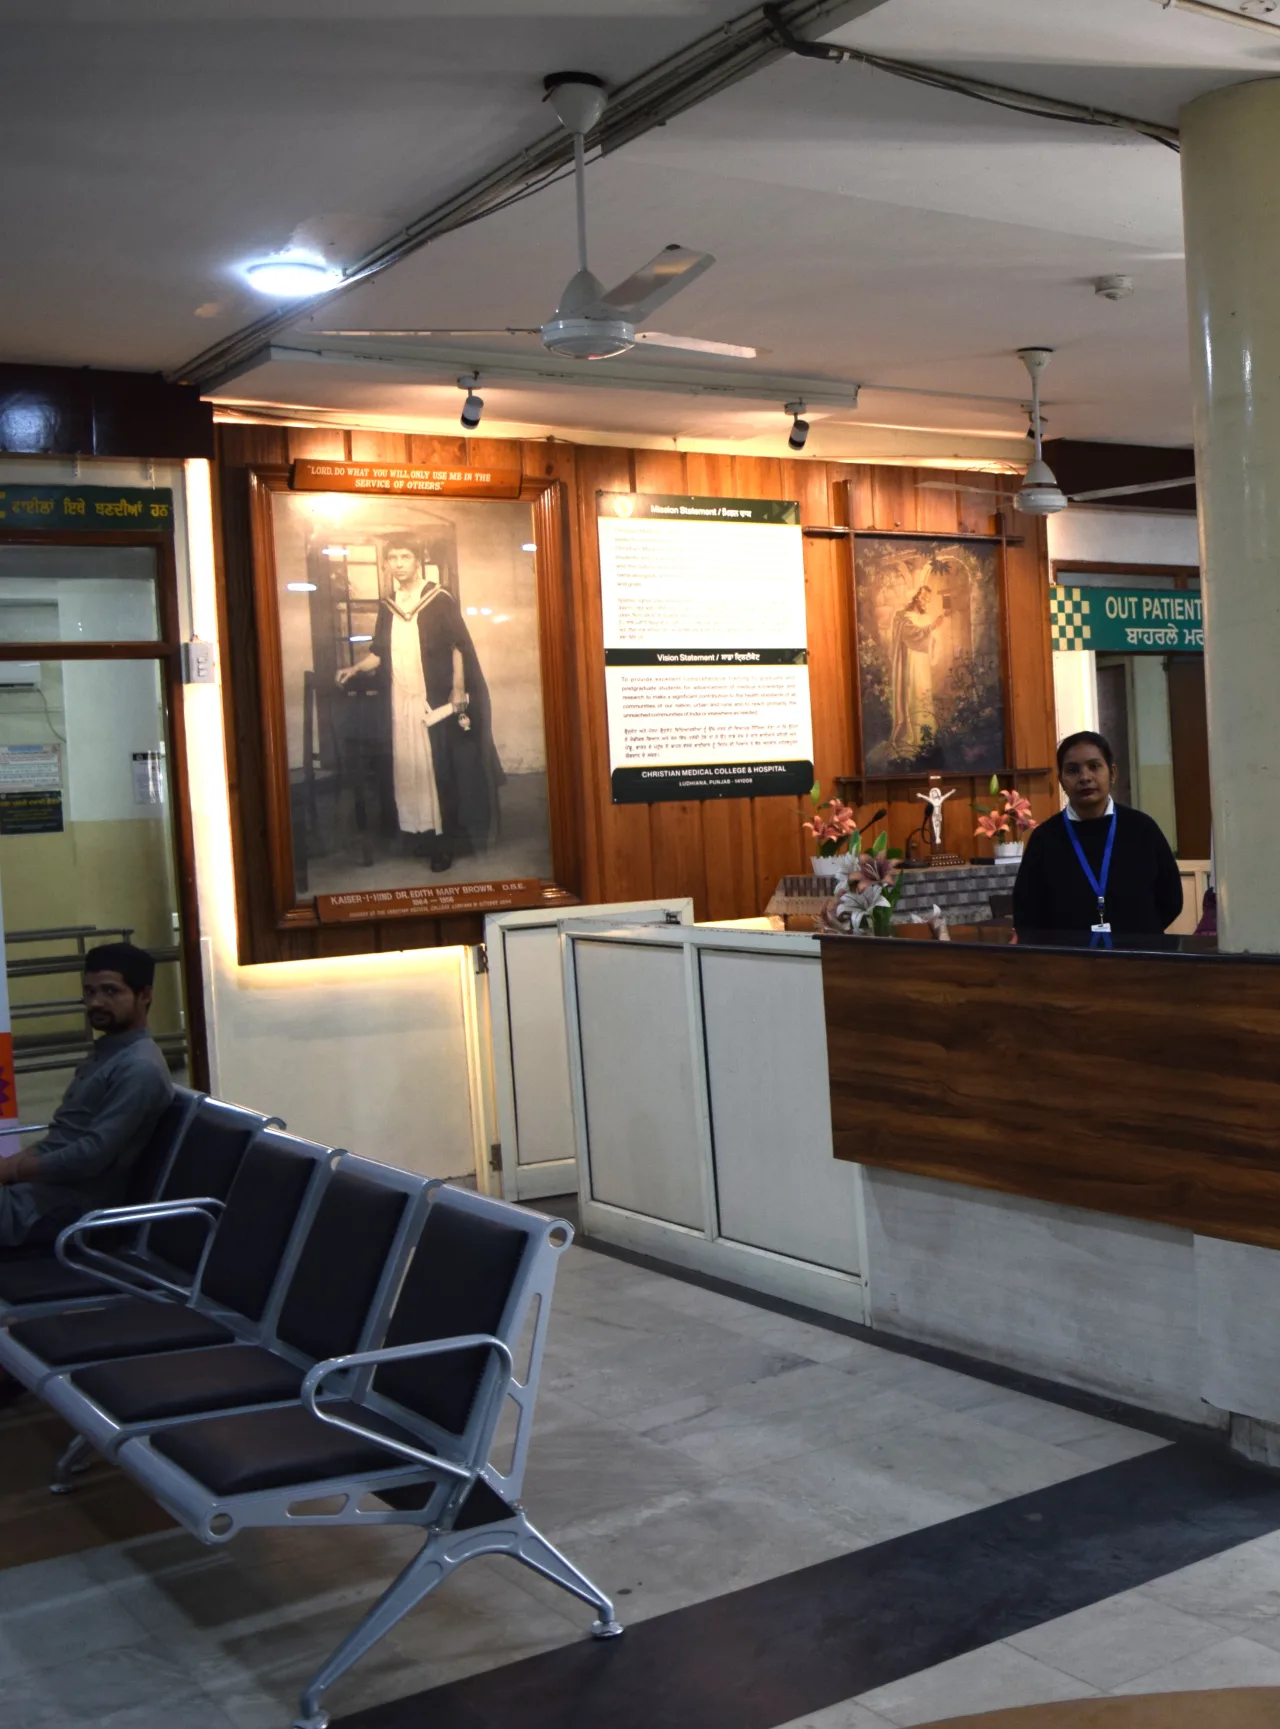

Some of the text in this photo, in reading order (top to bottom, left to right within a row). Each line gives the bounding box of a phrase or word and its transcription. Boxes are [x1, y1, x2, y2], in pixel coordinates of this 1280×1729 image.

[334, 468, 345, 476] DO
[347, 468, 369, 477] WHAT
[373, 469, 388, 478] YOU
[410, 470, 430, 480] ONLY
[432, 471, 447, 480] USE
[449, 472, 462, 481] ME
[464, 473, 473, 481] IN
[474, 473, 491, 482] THE
[355, 479, 391, 489] SERVICE
[393, 481, 404, 489] OF
[650, 504, 679, 514] Mission
[680, 506, 717, 516] Statement
[1105, 595, 1202, 621] OUT PATIENT
[656, 653, 679, 662] Vision
[680, 653, 715, 662] Statement
[642, 765, 787, 778] CHRISTIAN MEDICAL COLLEGE & HOSPITAL
[410, 888, 434, 899] EDITH
[436, 887, 460, 897] MARY
